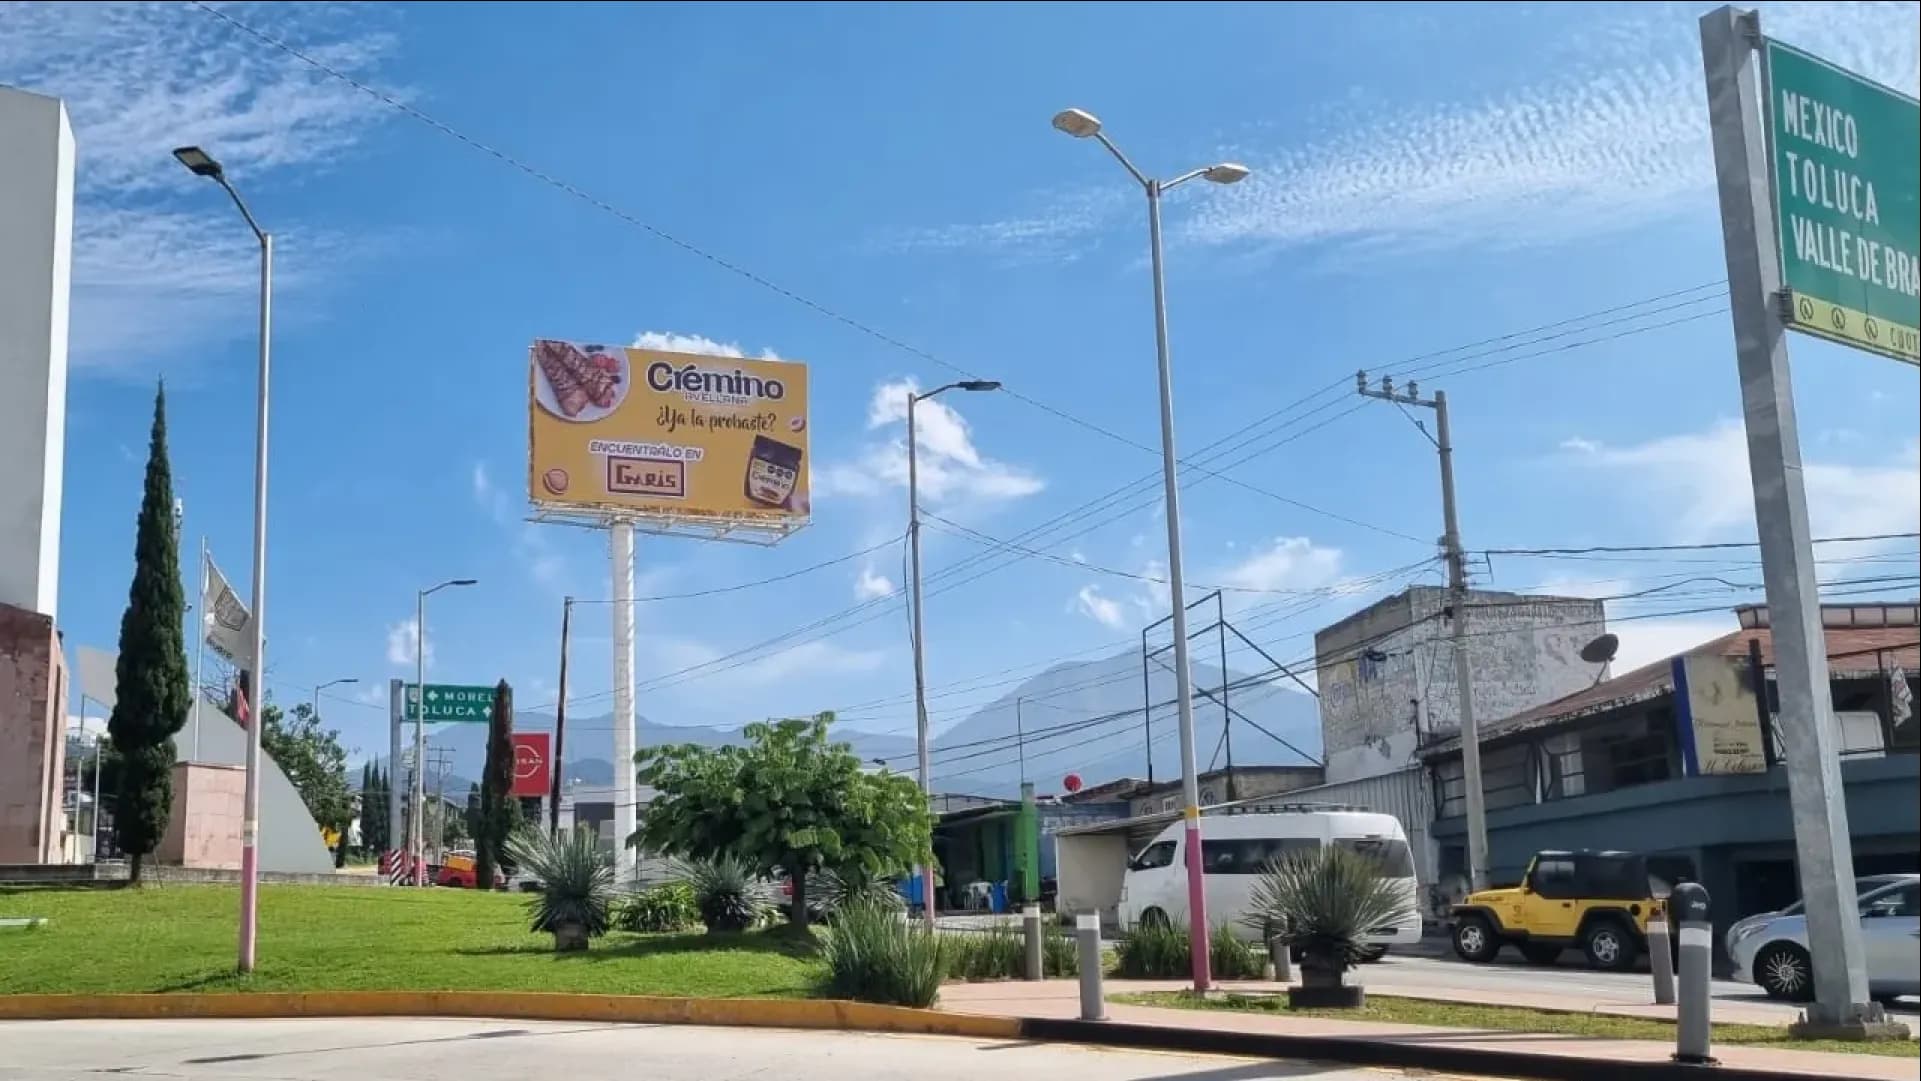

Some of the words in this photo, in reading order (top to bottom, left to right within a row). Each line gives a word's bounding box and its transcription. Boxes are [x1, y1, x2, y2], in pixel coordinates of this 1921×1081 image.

[1781, 88, 1858, 158] MEXICO
[1785, 150, 1879, 226] TOLUCA
[1790, 213, 1855, 277] VALLE
[1856, 236, 1883, 286] DE
[647, 361, 784, 400] Crémino
[691, 408, 705, 428] la
[708, 411, 777, 433] probaste?
[685, 448, 702, 459] EN
[408, 703, 477, 716] TOLUCA
[444, 691, 493, 703] MOREL
